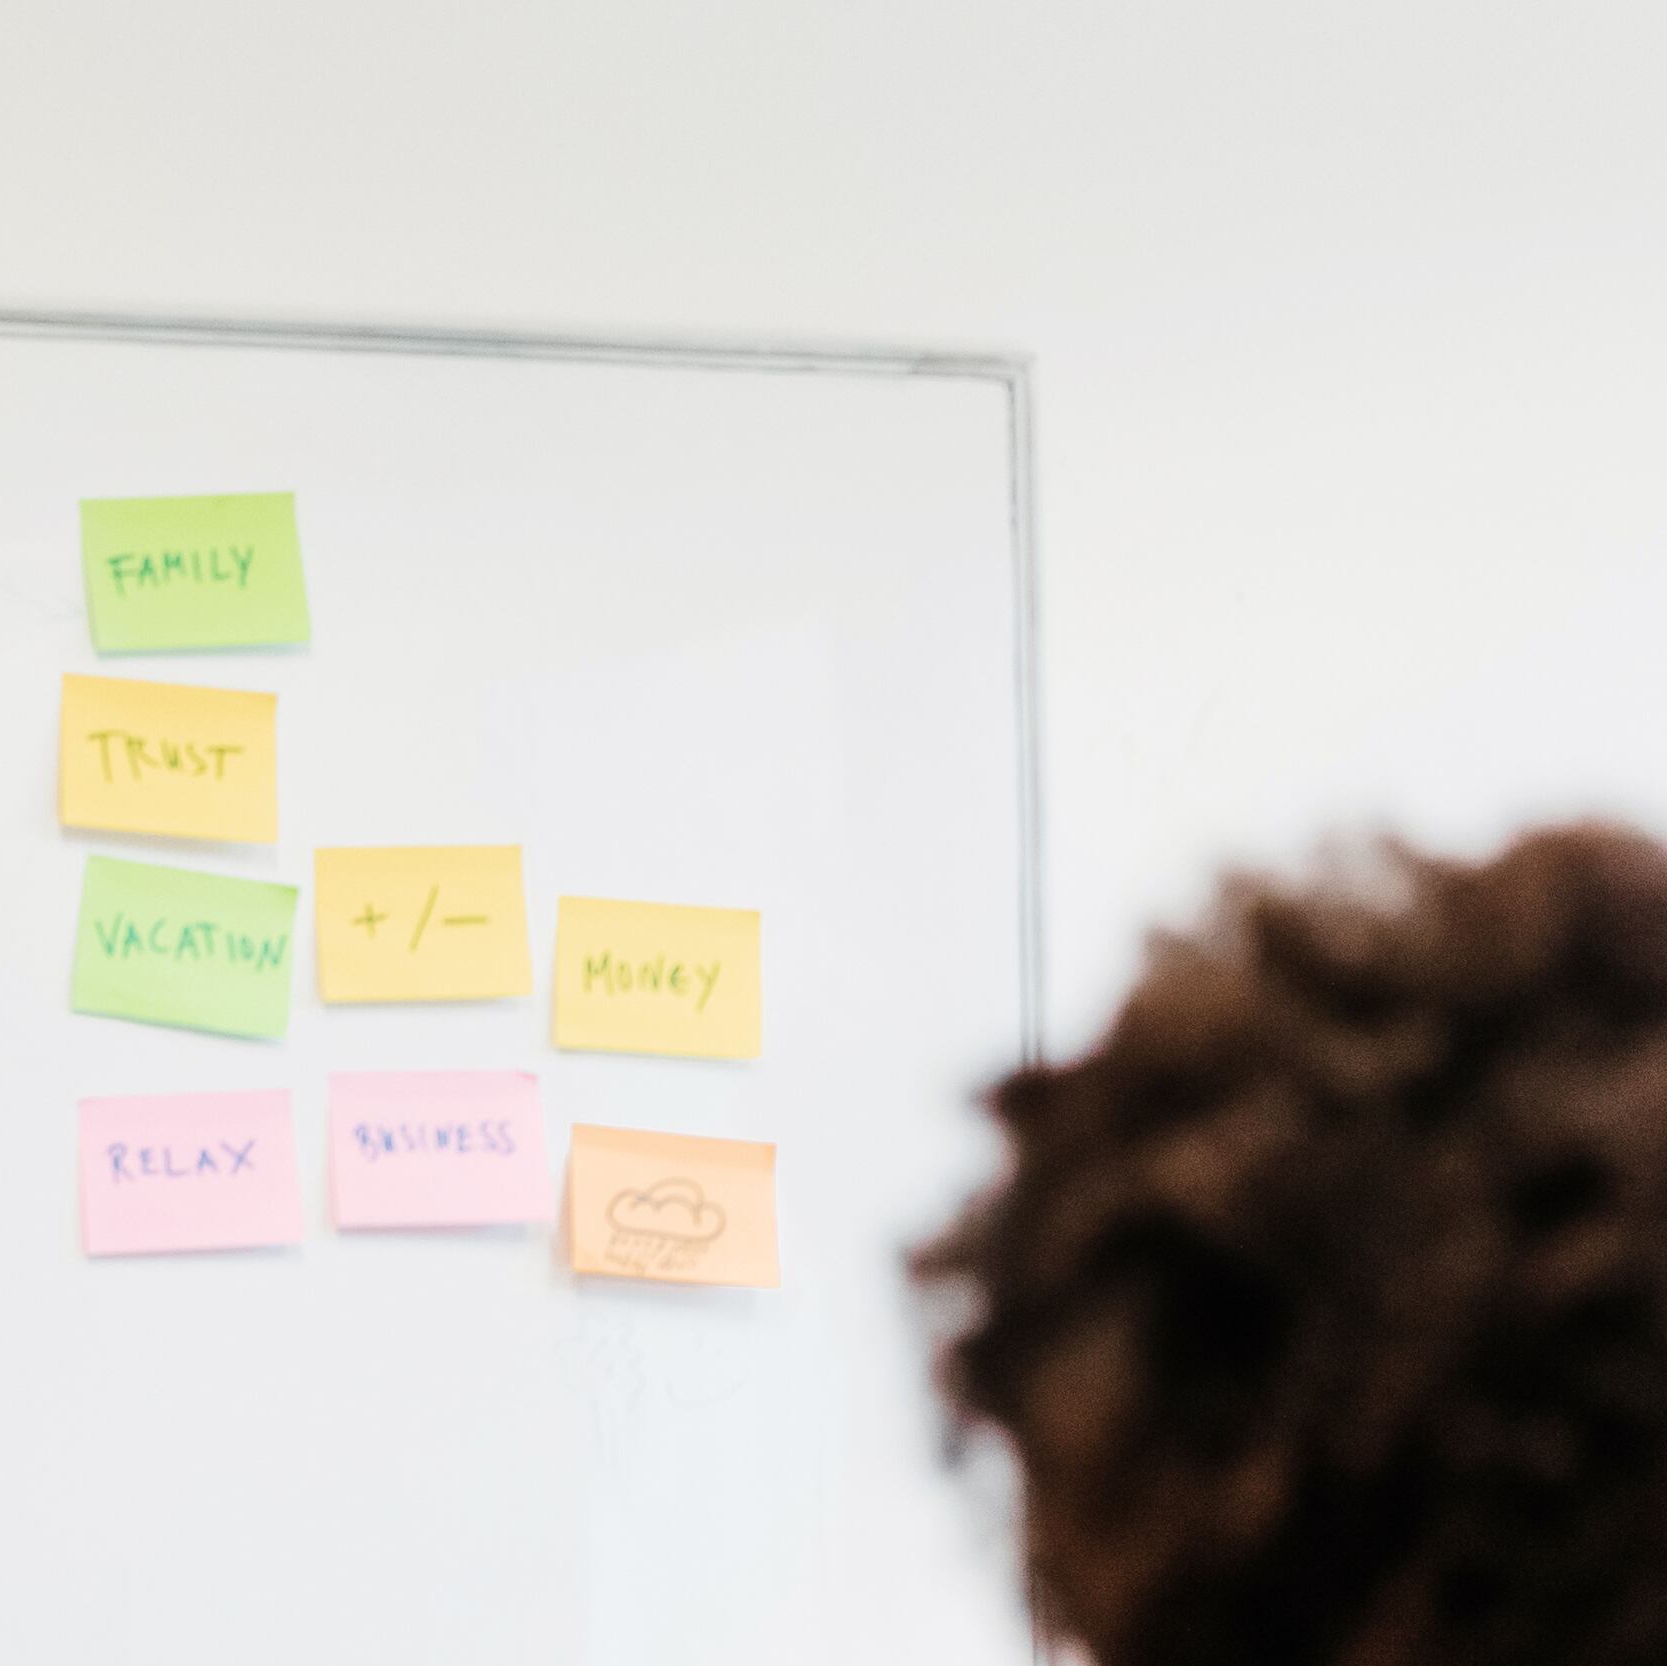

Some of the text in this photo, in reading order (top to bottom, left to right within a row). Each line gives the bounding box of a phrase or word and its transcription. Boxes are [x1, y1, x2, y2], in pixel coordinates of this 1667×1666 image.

[106, 546, 255, 594] FAMILY
[87, 729, 246, 784] TRUST
[93, 912, 287, 973] VACATION
[582, 948, 723, 1015] MONEY
[106, 1139, 257, 1186] RELAX
[352, 1120, 518, 1161] BUSINESS
